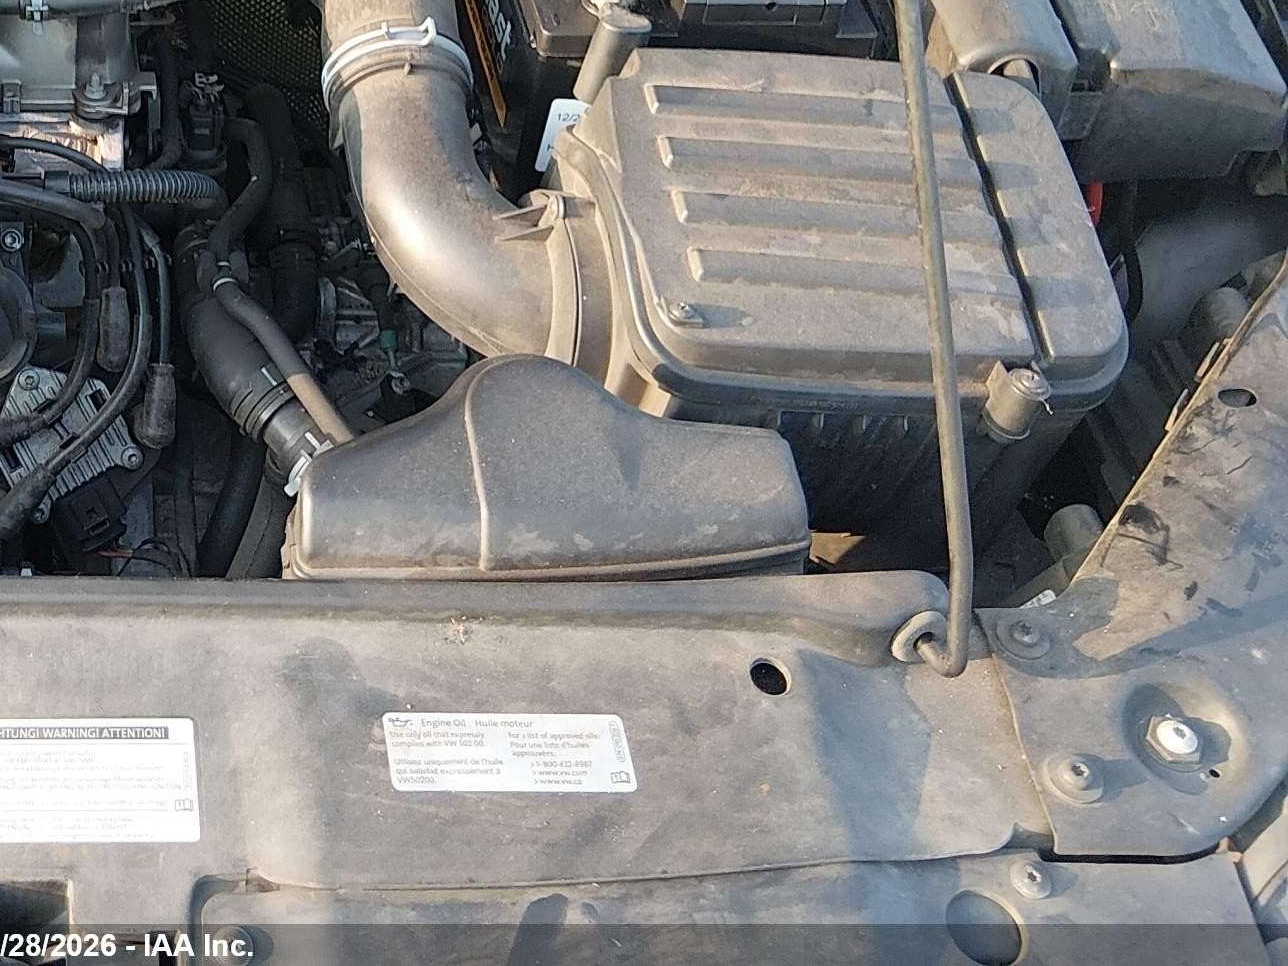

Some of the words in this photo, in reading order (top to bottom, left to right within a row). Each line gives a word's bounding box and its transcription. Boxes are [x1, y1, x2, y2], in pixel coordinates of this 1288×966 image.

[421, 718, 451, 728] Engine
[453, 718, 466, 727] Oil
[475, 718, 498, 727] Huile
[500, 719, 533, 728] moteur
[41, 728, 99, 739] WARNING!
[101, 728, 165, 739] ATTENTION!
